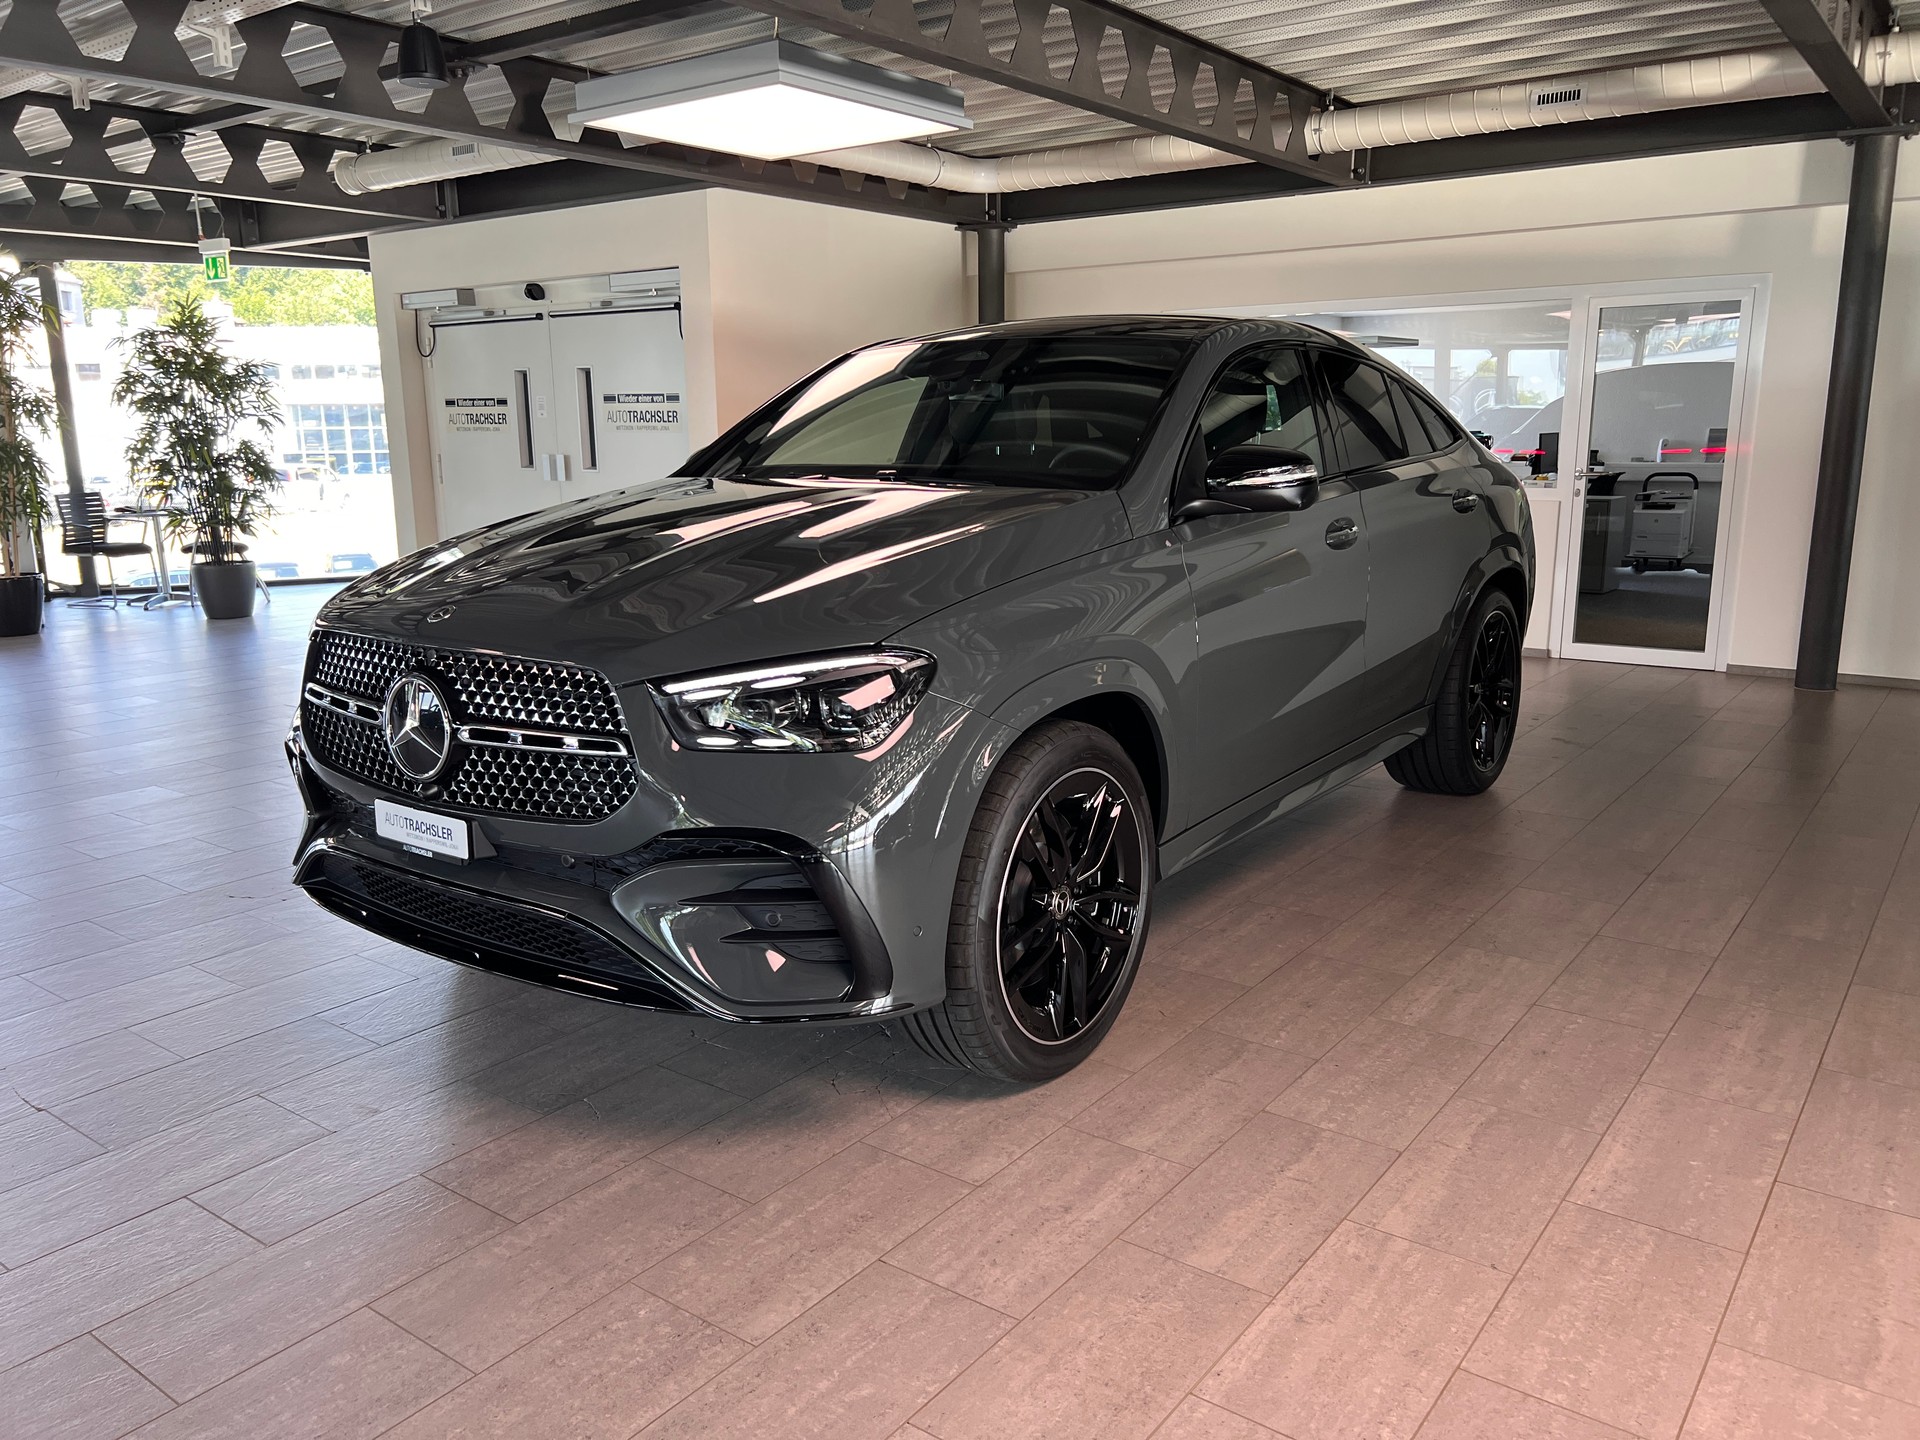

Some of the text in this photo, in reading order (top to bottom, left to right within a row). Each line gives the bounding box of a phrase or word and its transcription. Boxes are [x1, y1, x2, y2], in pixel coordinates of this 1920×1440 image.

[458, 399, 473, 407] Wieder
[474, 399, 485, 407] einer
[619, 394, 664, 403] Wieder einer von
[448, 413, 508, 425] AUTOTRACHSLER
[607, 410, 678, 423] AUTOTRACHSLER
[384, 812, 453, 841] AUTOTRACHSLER
